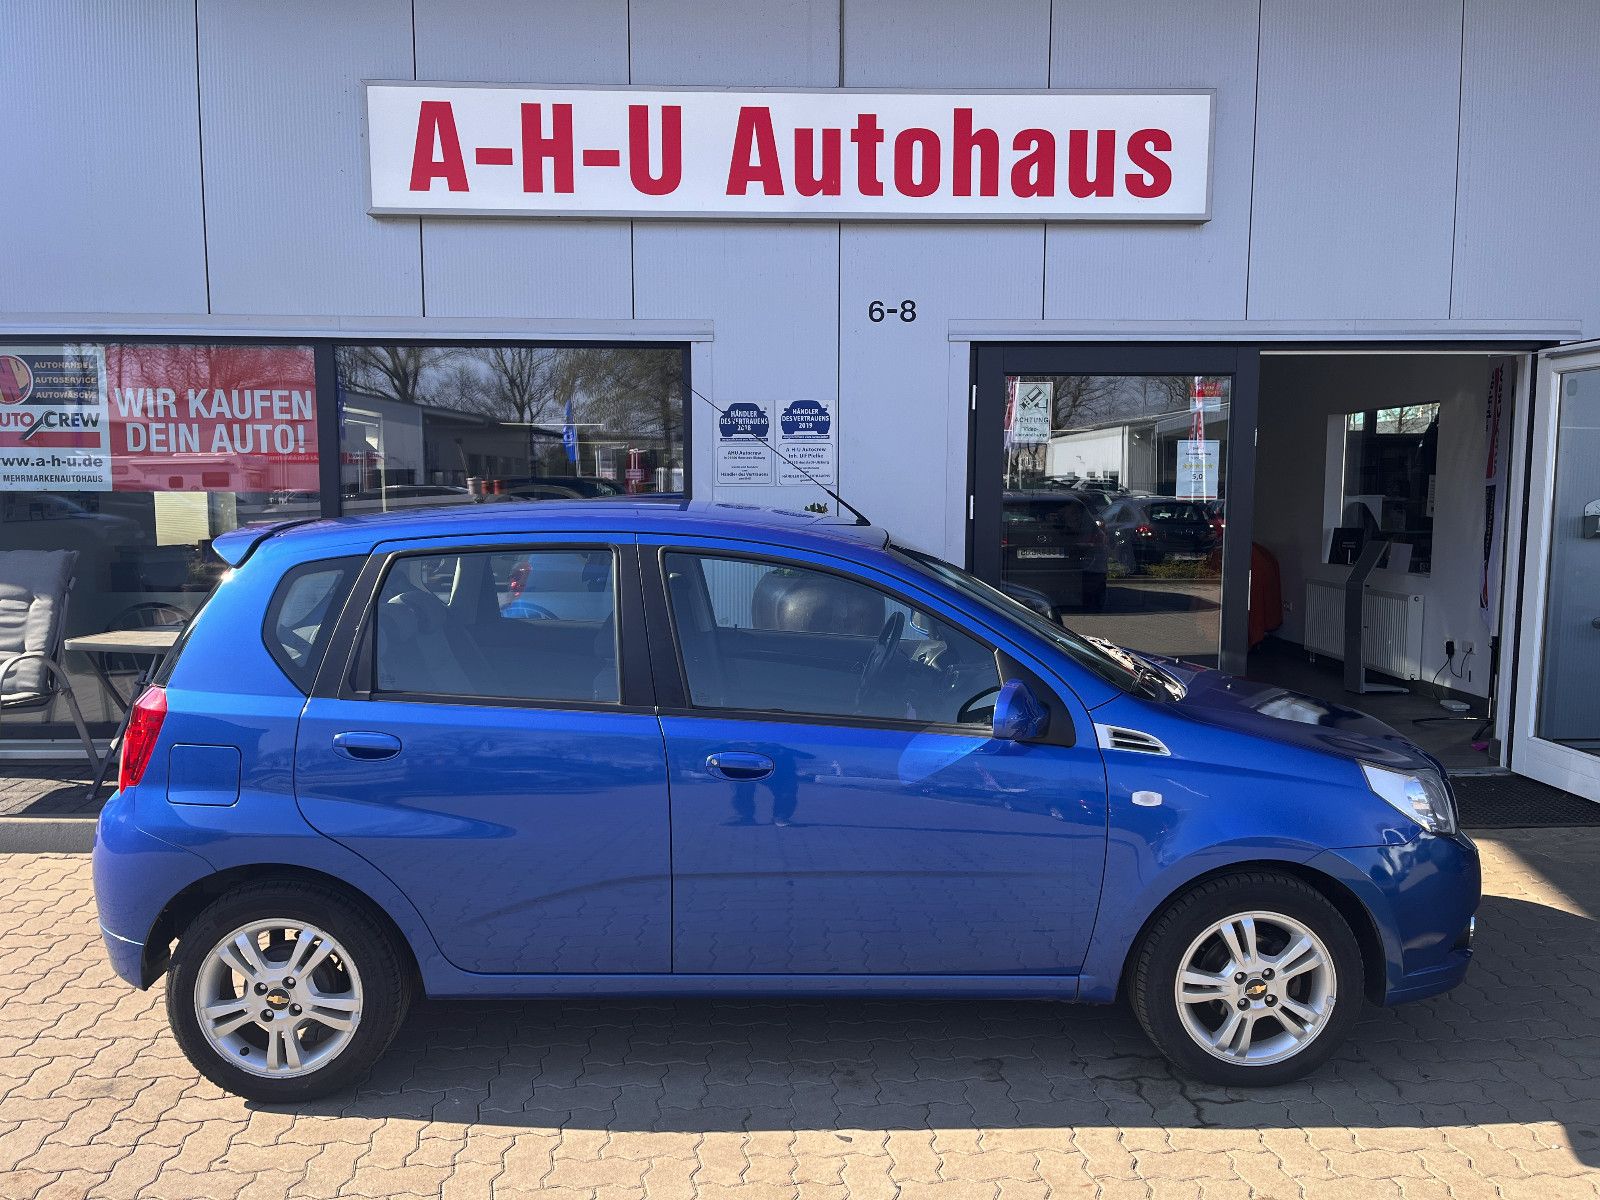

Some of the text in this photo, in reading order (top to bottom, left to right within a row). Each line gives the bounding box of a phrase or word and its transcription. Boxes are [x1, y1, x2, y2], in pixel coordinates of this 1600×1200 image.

[409, 101, 1173, 199] A-H-U Autohaus
[868, 300, 917, 323] 6-8
[34, 361, 94, 369] AUTOHANDEL
[114, 387, 313, 421] WIR KAUFEN
[0, 412, 35, 428] UTO
[127, 423, 305, 455] DEIN AUTO!
[0, 455, 103, 467] ww.a-h-u.de
[3, 474, 103, 483] MEHRMARKENAUTOHAUS
